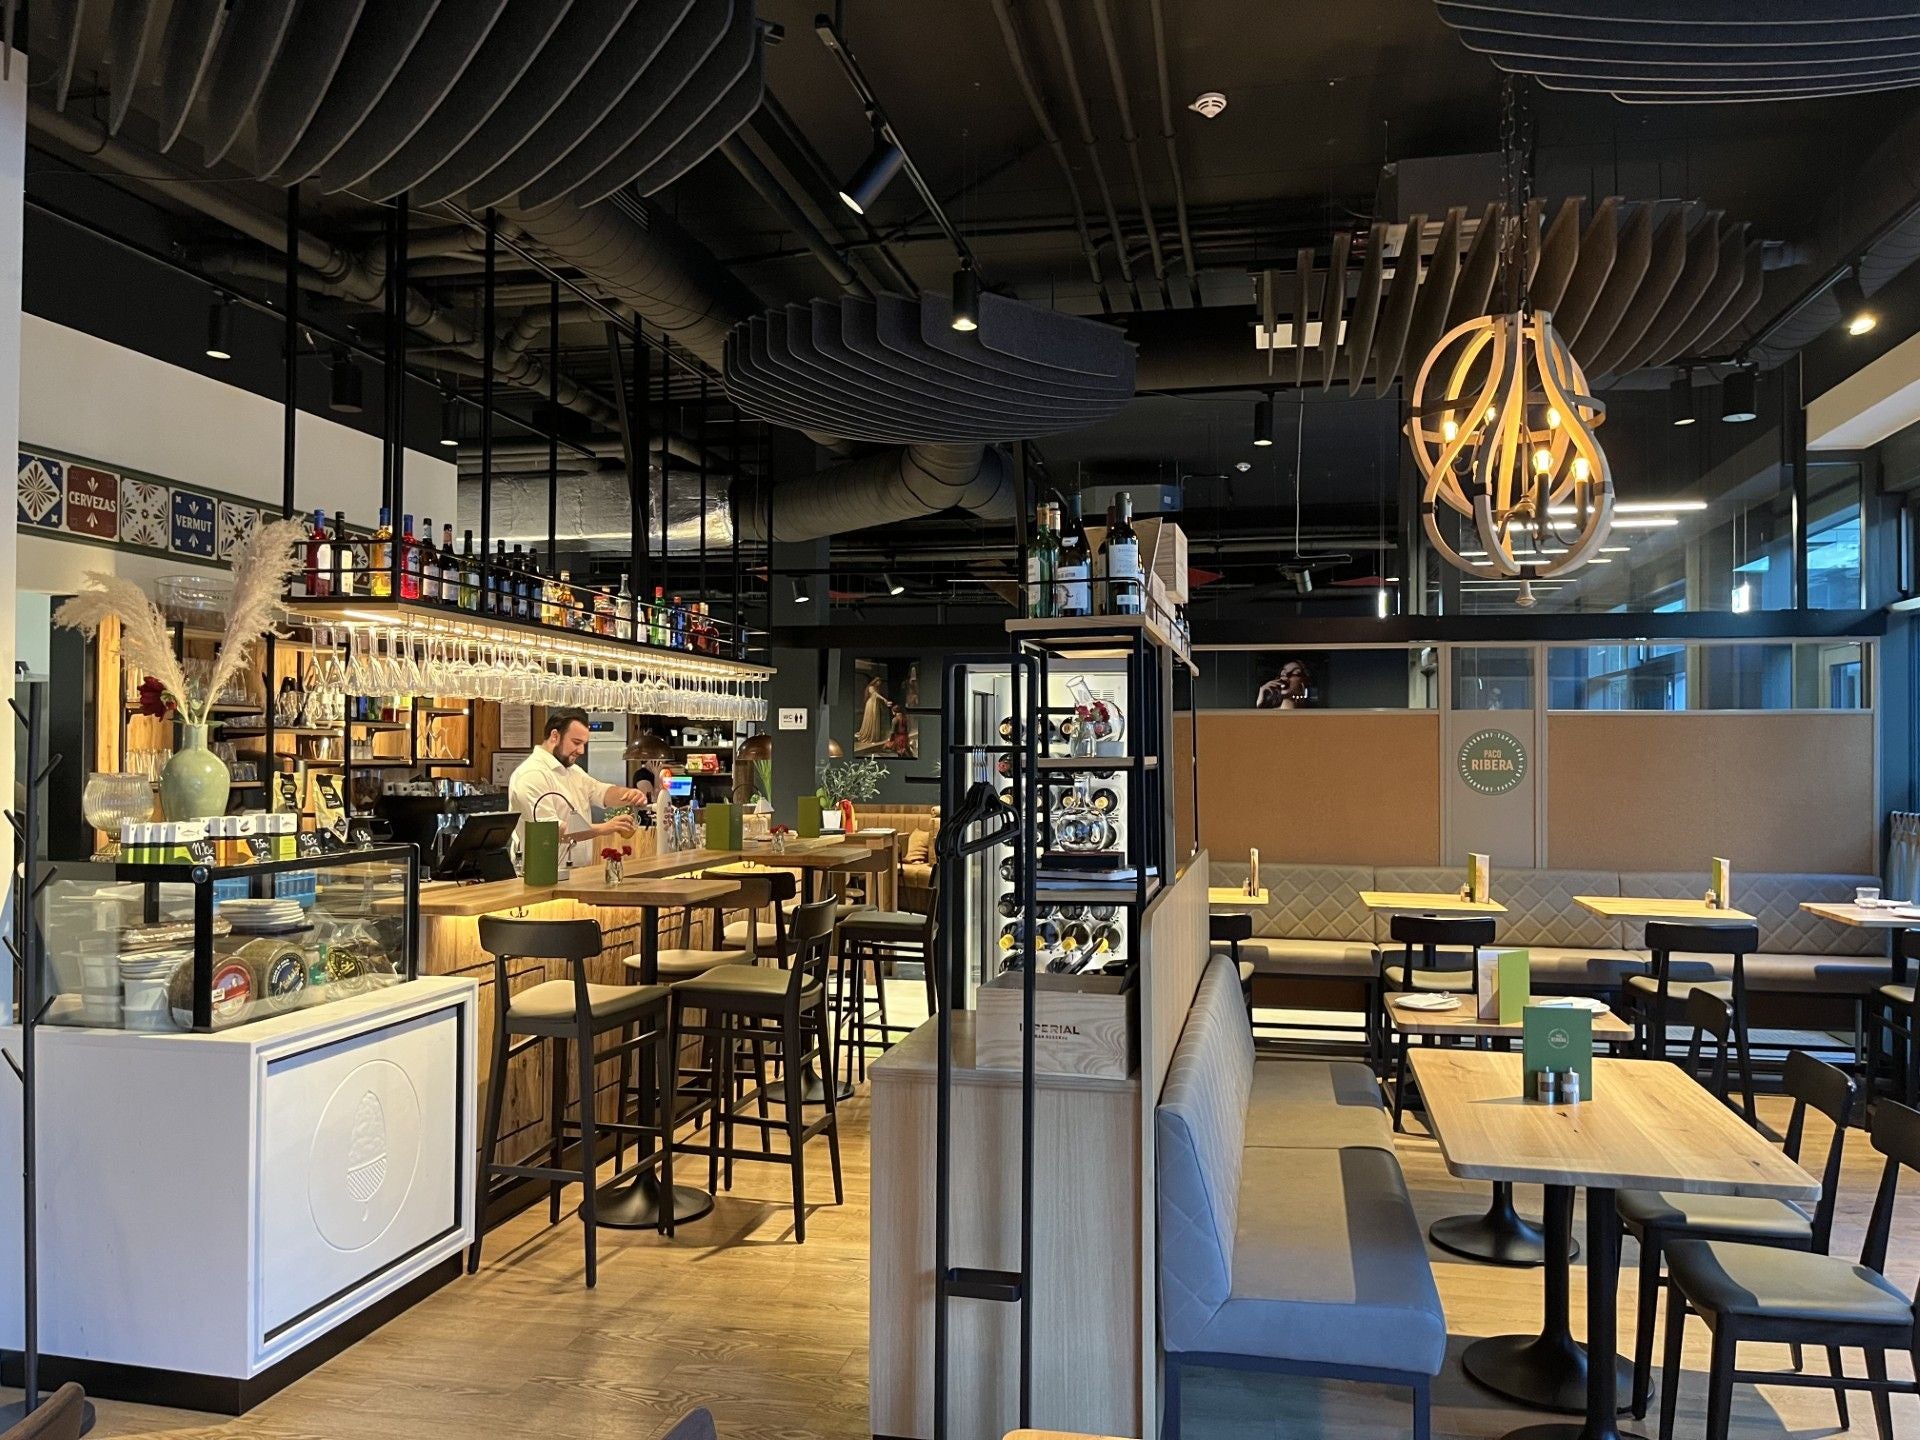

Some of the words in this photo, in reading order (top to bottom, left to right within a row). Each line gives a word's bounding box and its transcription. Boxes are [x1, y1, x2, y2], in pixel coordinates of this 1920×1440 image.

[69, 491, 116, 512] CERVEZAS
[175, 514, 212, 533] VERMUT
[1483, 749, 1502, 758] PACO
[1471, 759, 1514, 771] RIBERA
[1019, 1023, 1080, 1035] IPERIAL
